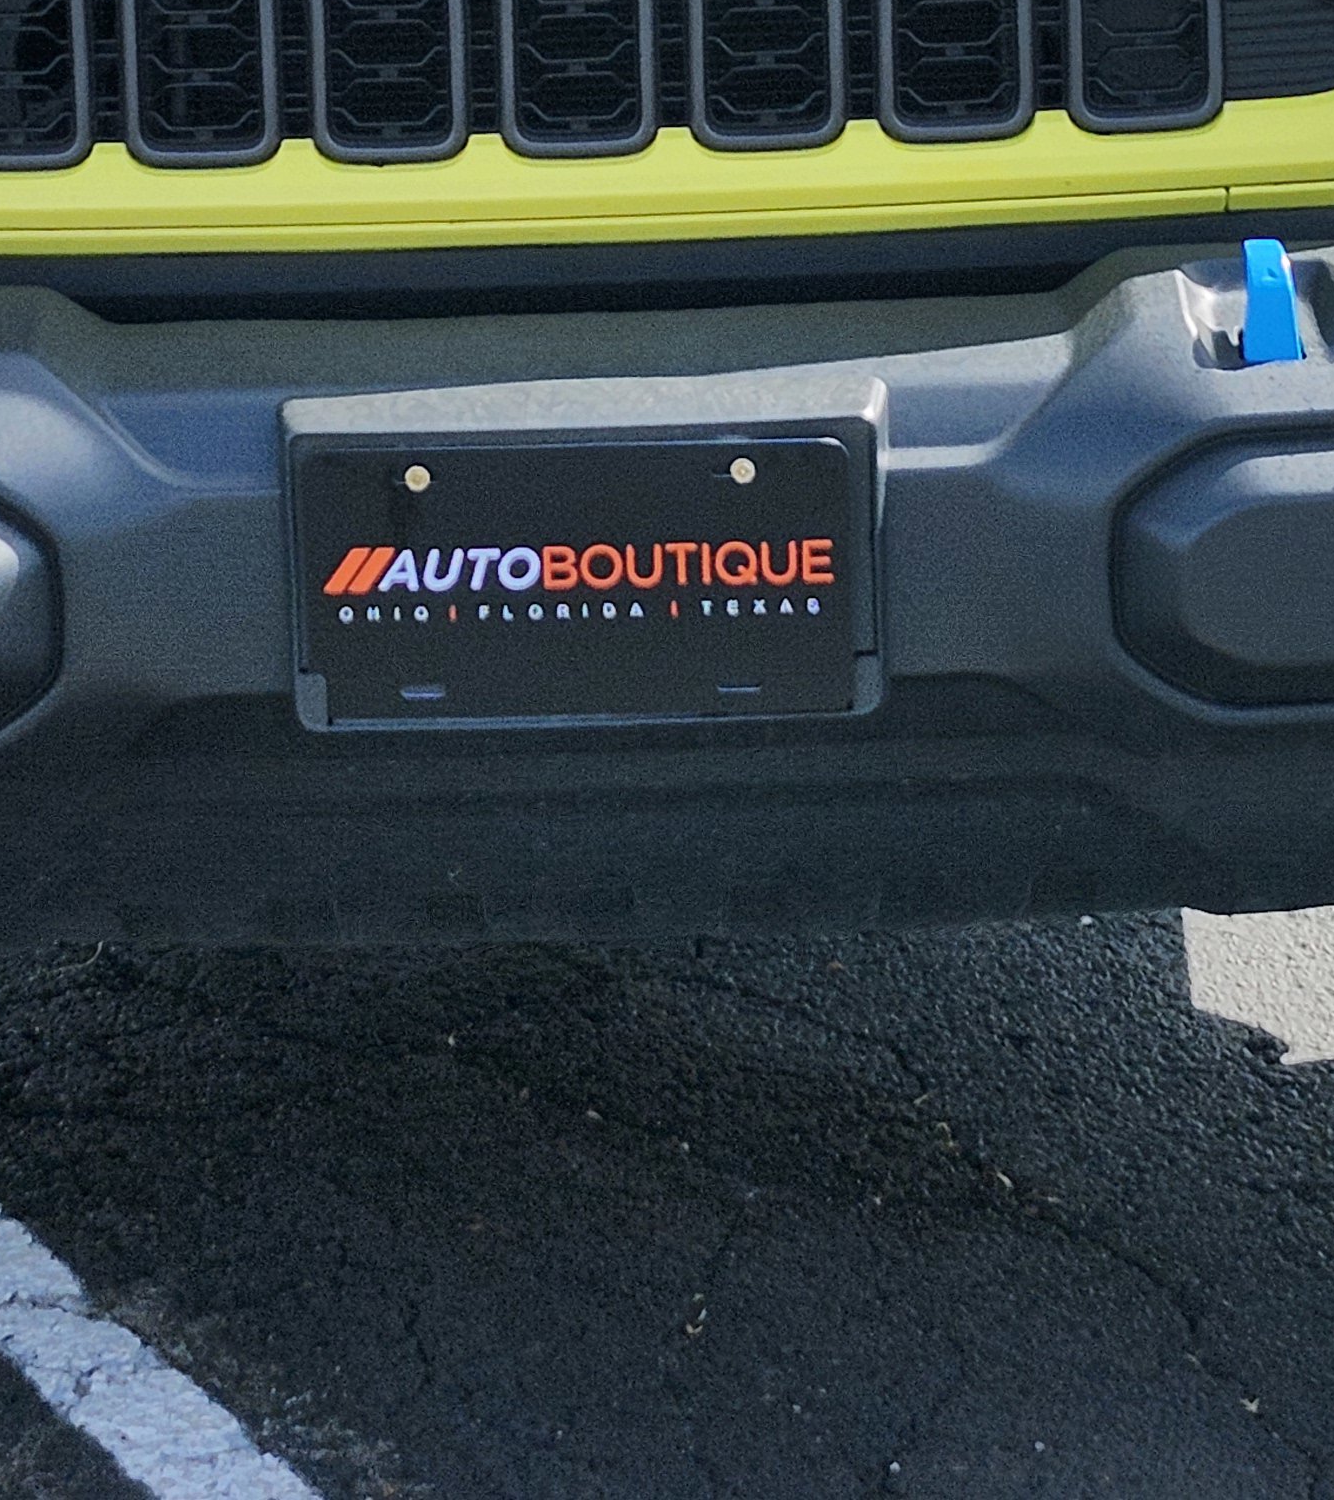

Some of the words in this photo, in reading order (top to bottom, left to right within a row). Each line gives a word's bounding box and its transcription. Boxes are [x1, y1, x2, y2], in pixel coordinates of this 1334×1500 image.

[338, 605, 430, 624] OHIO
[478, 602, 645, 621] FLORIDA
[701, 597, 821, 617] TEXAS
